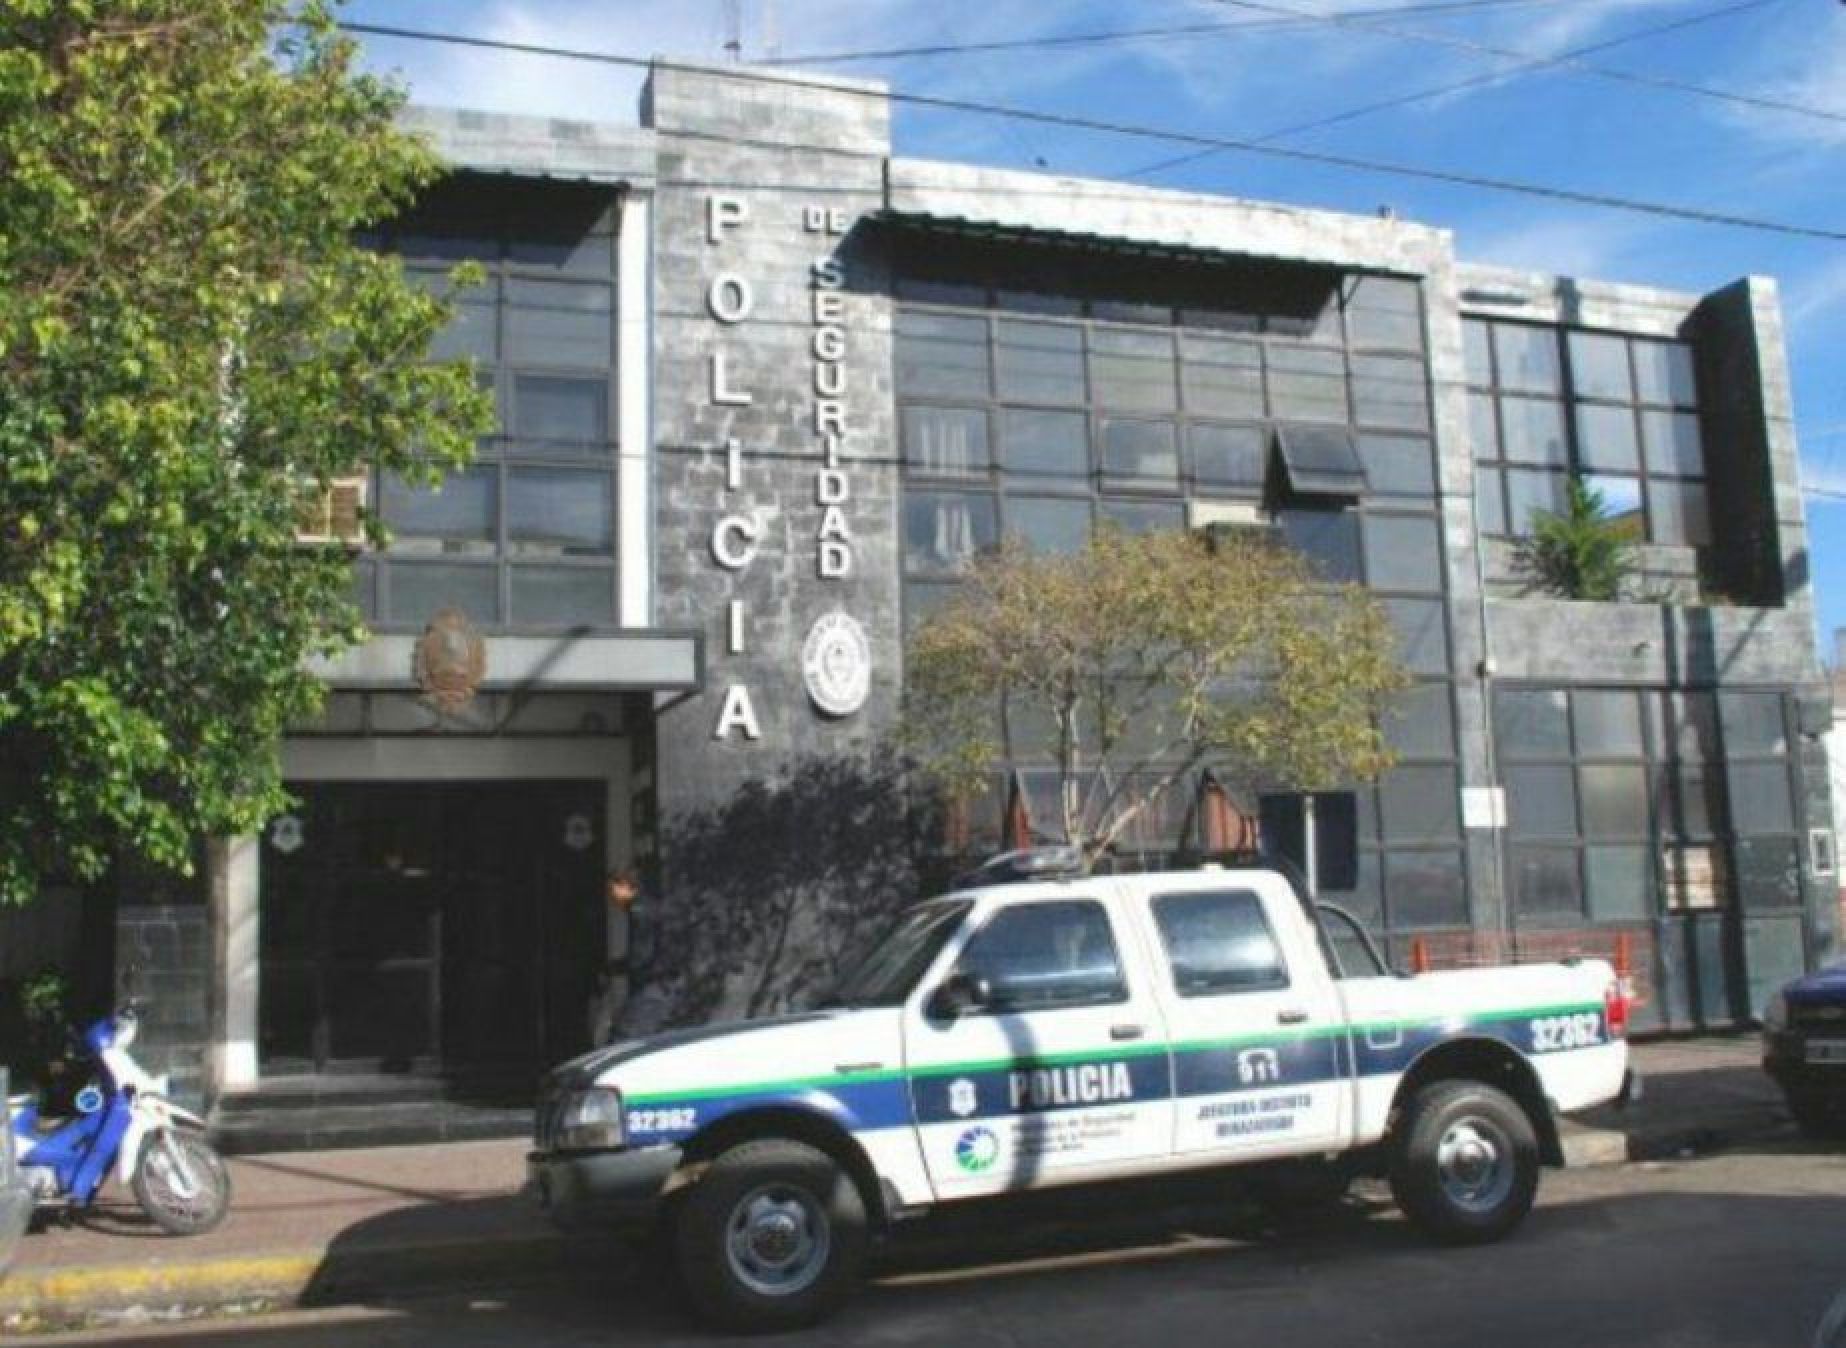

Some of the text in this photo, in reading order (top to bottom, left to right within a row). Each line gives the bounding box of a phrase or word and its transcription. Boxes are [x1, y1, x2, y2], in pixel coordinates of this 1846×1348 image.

[804, 206, 847, 234] DE
[708, 197, 761, 739] POLICIA
[813, 255, 850, 578] SEGURIDAD
[1008, 1061, 1133, 1109] POLICIA
